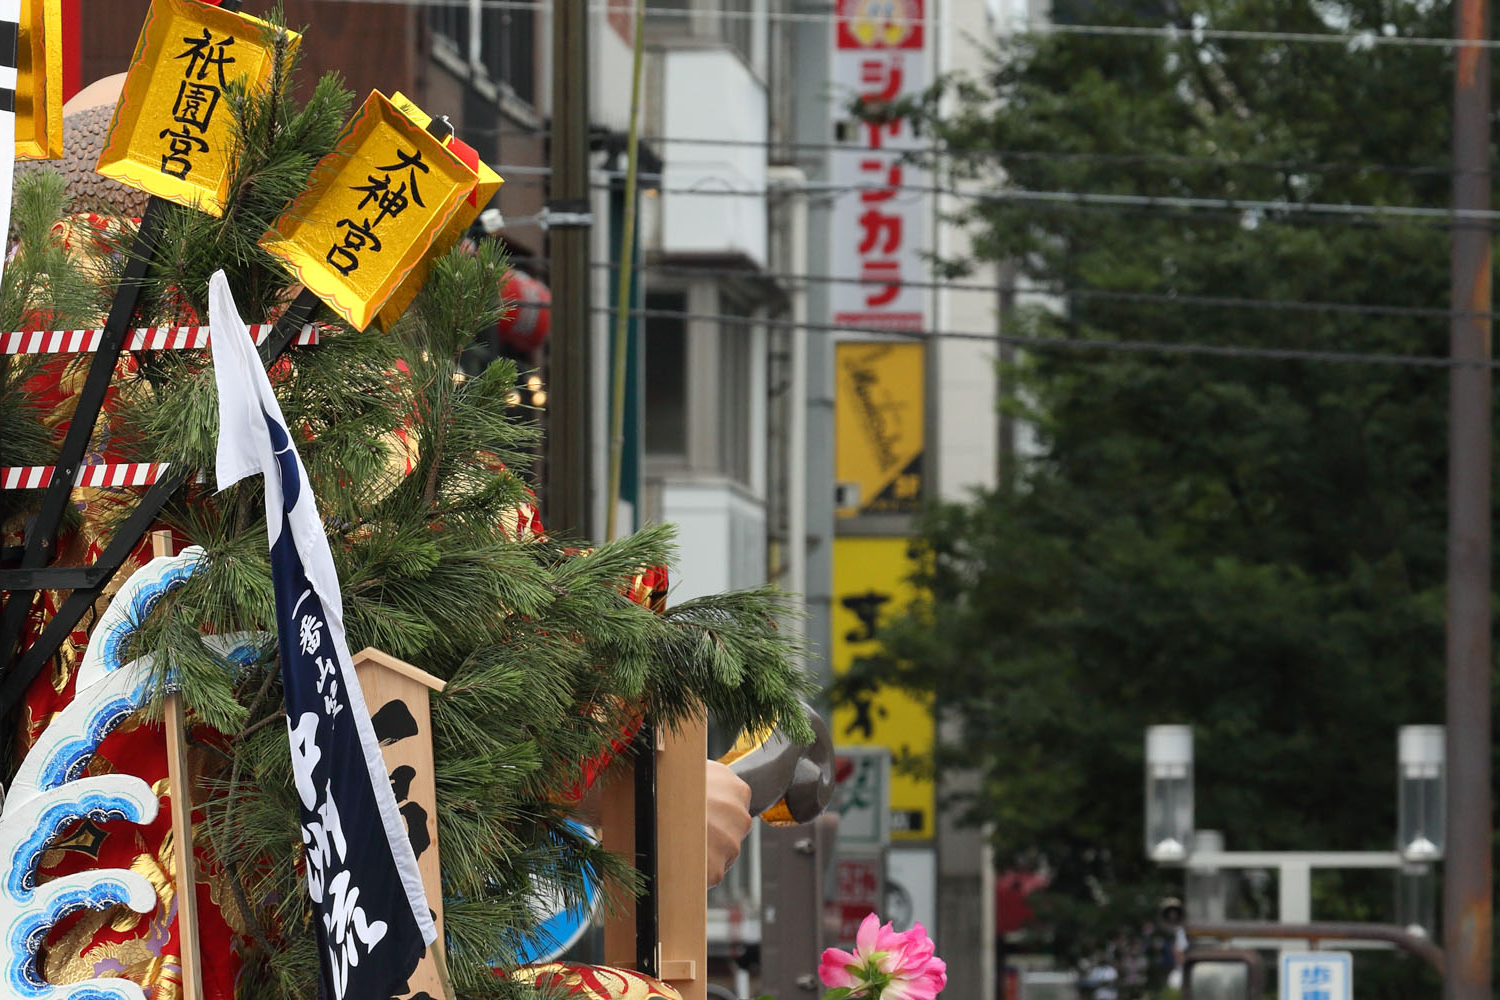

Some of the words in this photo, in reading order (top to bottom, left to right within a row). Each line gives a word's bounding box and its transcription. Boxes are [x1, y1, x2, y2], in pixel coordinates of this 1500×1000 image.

[159, 28, 236, 181] 祇園宮
[326, 149, 430, 277] 大神宮
